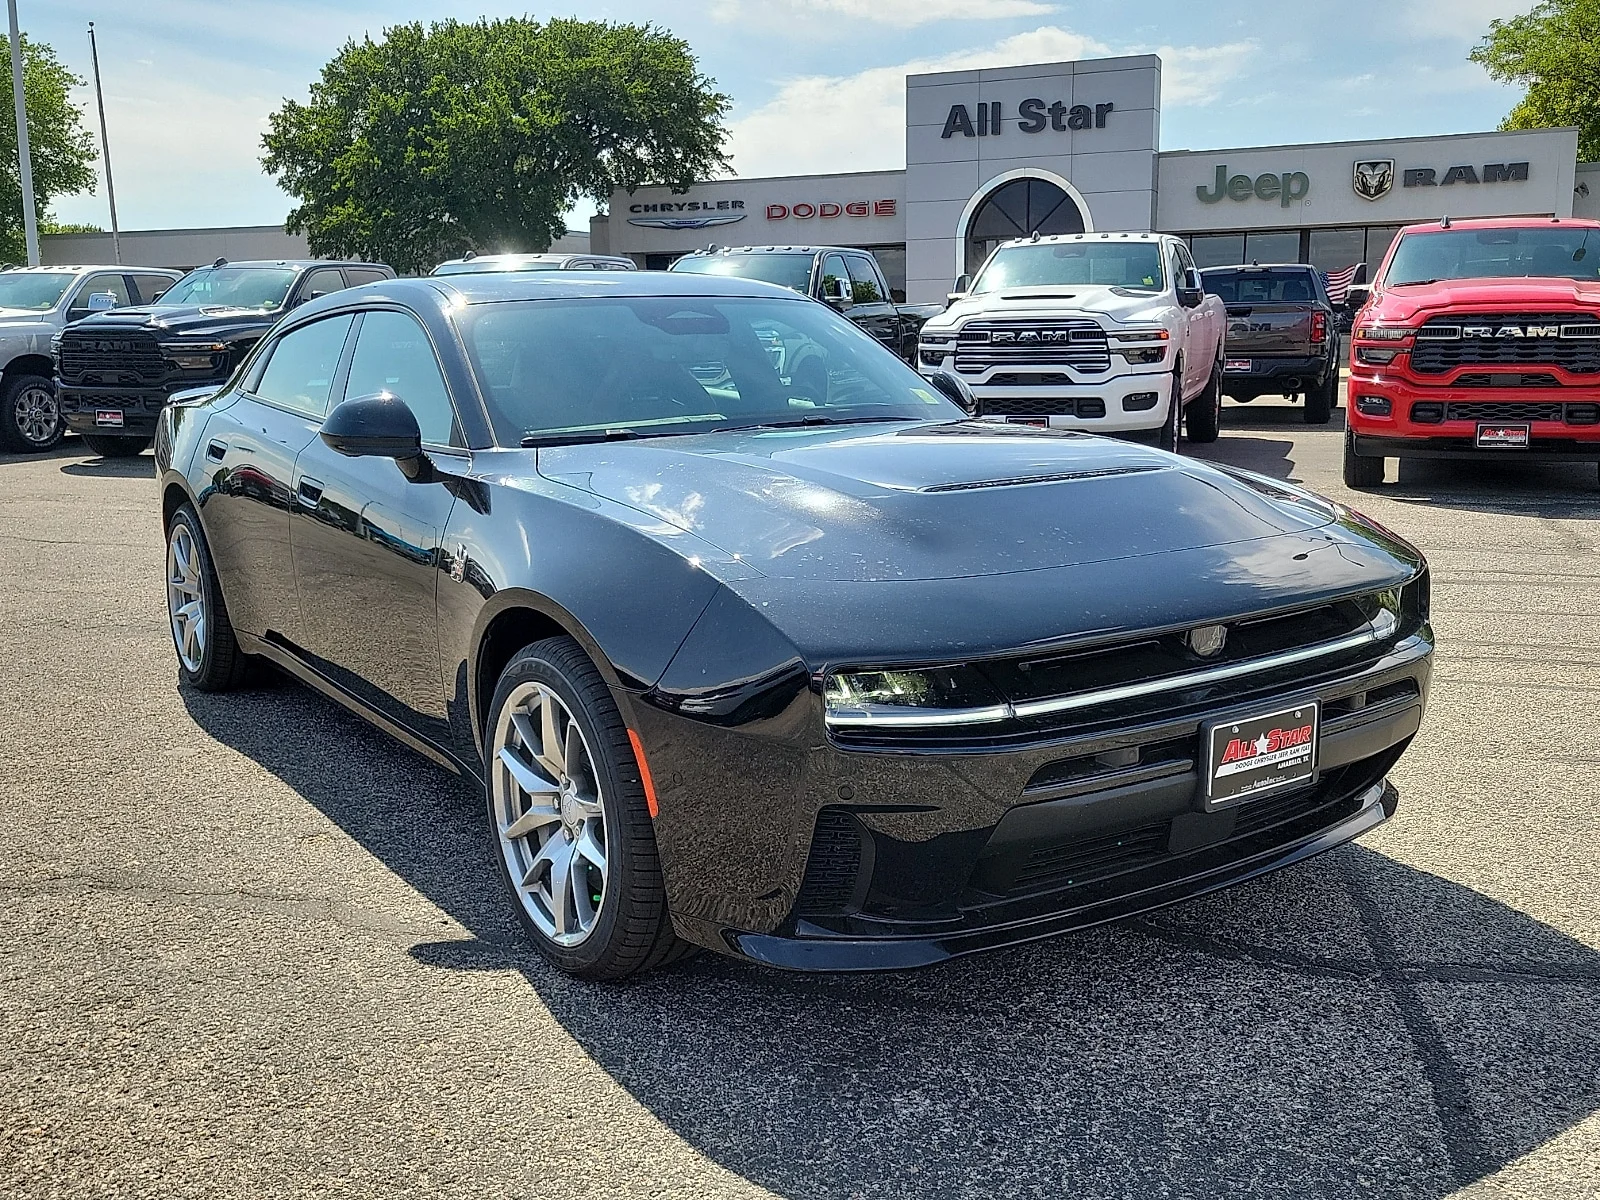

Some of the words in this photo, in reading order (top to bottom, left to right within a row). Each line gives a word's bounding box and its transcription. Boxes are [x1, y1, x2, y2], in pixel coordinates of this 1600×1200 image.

[940, 102, 1001, 138] All
[1017, 98, 1114, 134] Star
[1403, 162, 1529, 187] RAM
[1196, 165, 1310, 208] Jeep
[629, 200, 745, 213] CHRYSLER
[765, 199, 896, 220] DODGE
[1228, 323, 1272, 332] AM
[1462, 326, 1559, 338] RAM
[991, 330, 1067, 342] RAM
[81, 340, 132, 350] RAM
[1266, 725, 1312, 752] STAR
[1235, 760, 1254, 769] DODGE
